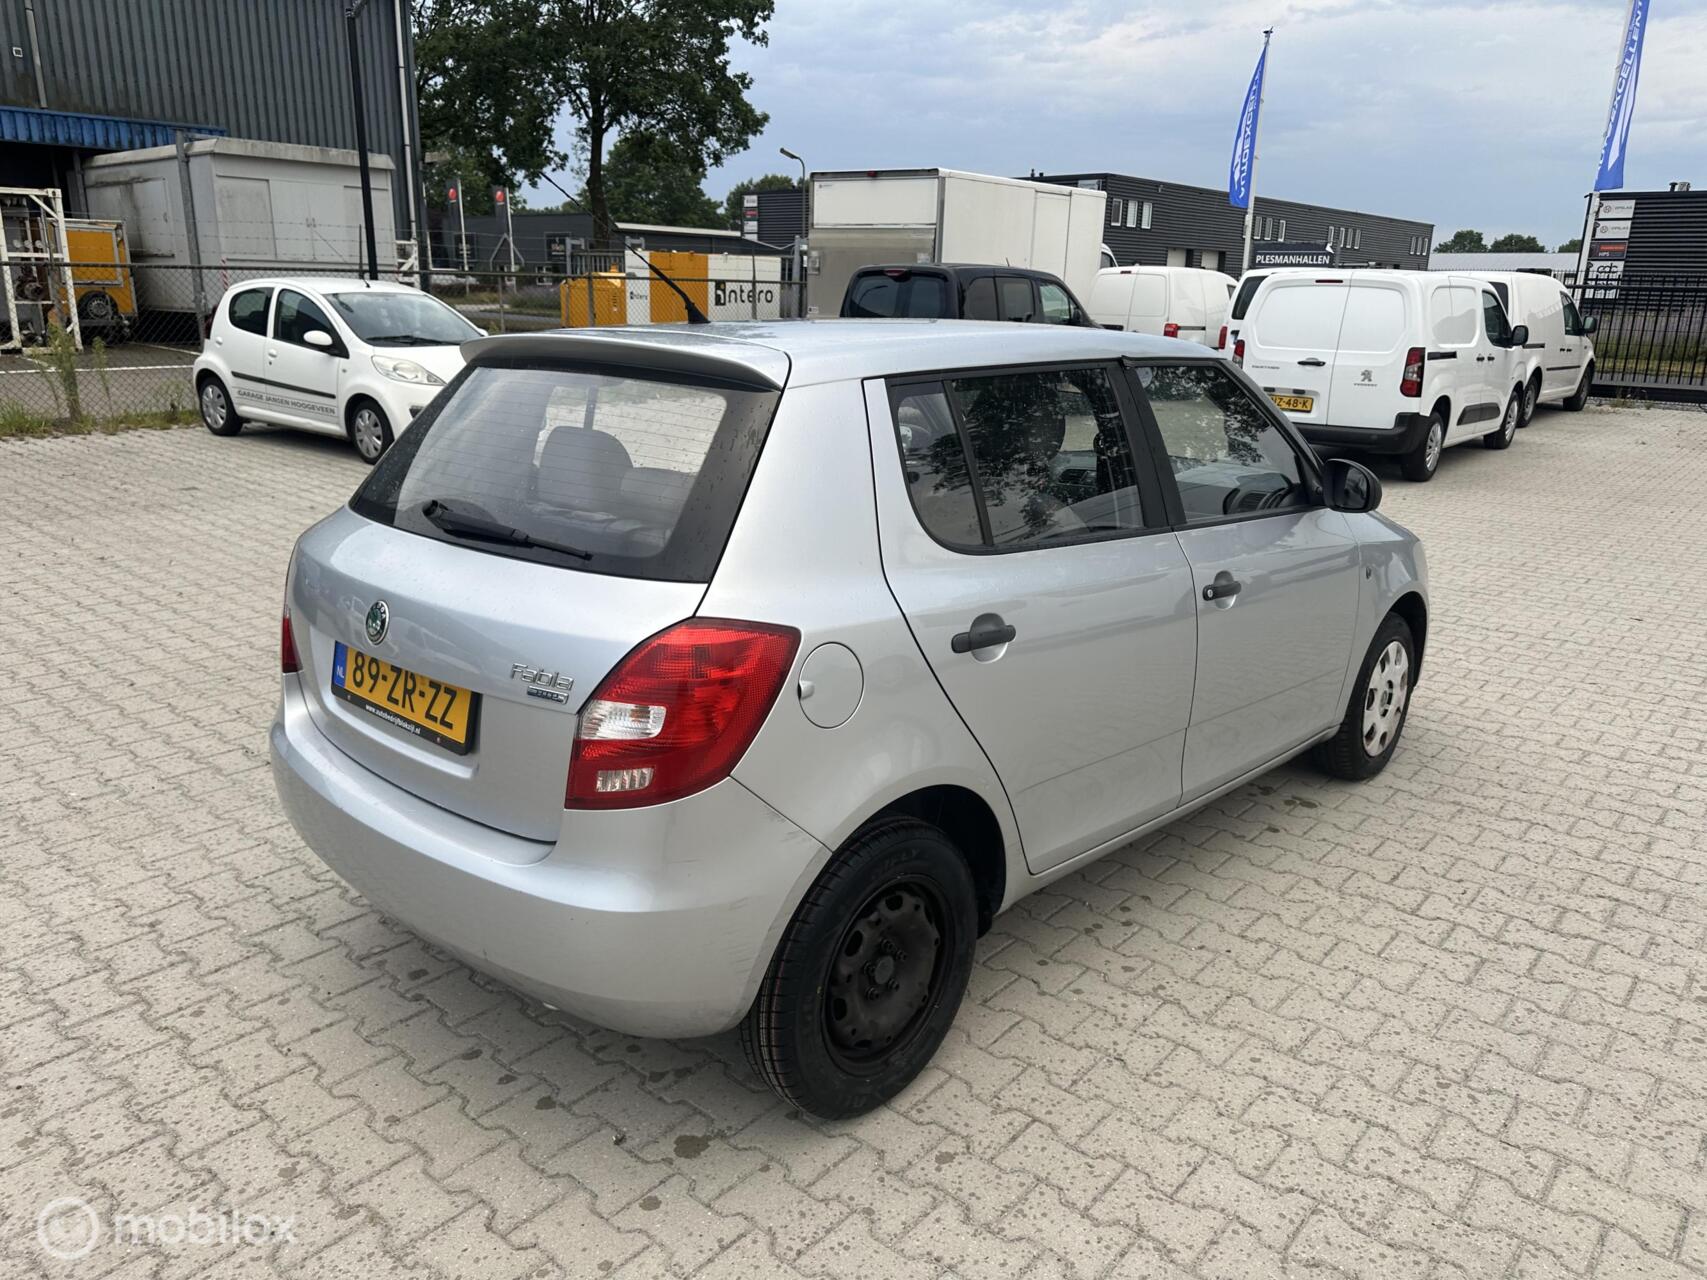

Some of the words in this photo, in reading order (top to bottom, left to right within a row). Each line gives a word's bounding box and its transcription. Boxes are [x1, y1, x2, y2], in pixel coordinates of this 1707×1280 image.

[1255, 255, 1330, 265] PLESMANHALLEN
[237, 390, 264, 401] GARAGE
[290, 400, 335, 415] HOOGEVEEN
[336, 665, 345, 678] NL
[511, 663, 574, 691] Fabia
[352, 651, 458, 731] 89-ZR-ZZ
